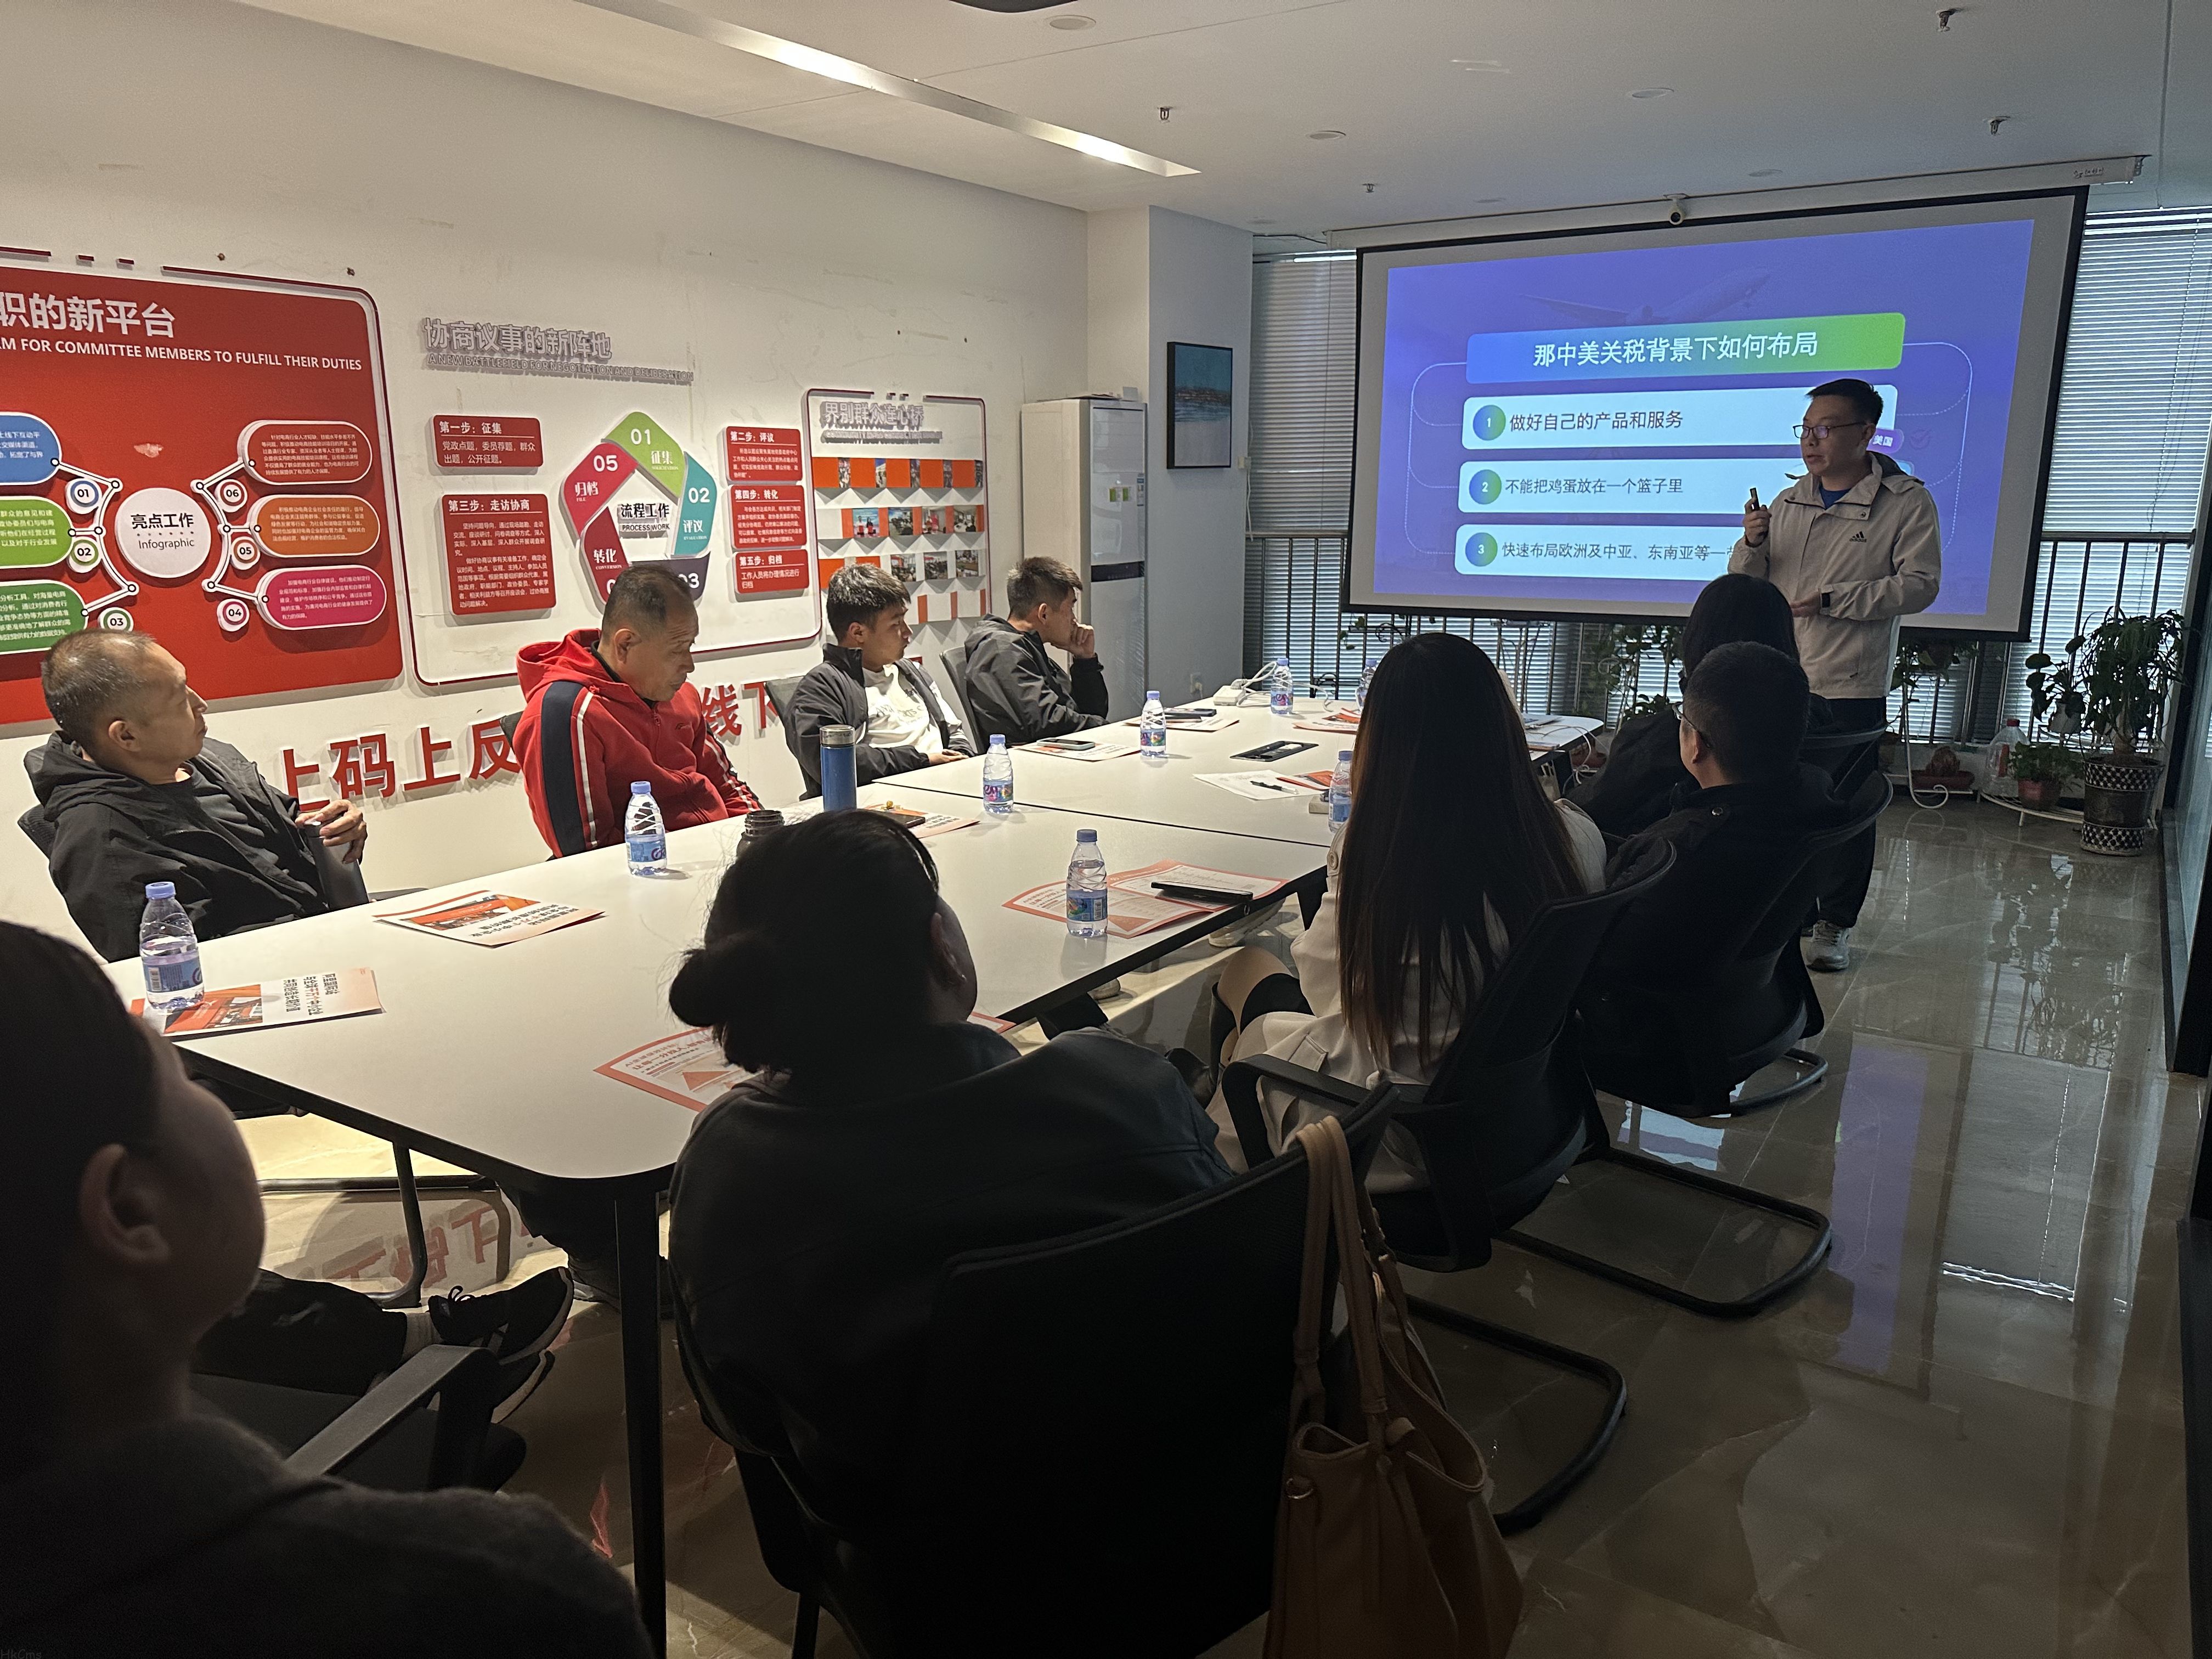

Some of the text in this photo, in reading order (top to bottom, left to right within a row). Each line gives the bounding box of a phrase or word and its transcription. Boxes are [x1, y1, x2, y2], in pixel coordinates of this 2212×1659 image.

[0, 291, 176, 338] 职的新平台
[424, 318, 613, 359] 协商议事的新阵地
[21, 338, 51, 353] FOR
[55, 340, 142, 358] COMMITTEE
[145, 346, 211, 362] MEMBERS
[215, 350, 232, 362] TO
[236, 352, 281, 366] FULFILL
[284, 356, 319, 368] THEIR
[322, 357, 362, 370] DUTIES
[1533, 331, 1818, 368] 那中美关税背景下如何布局
[428, 355, 693, 381] A NEW BATTLEFIELD FOR NEGOTIATION AND DELIBERATION
[825, 402, 924, 426] 界别群众连心桥
[1486, 410, 1683, 432] 1 做好自己的产品和服务
[439, 421, 502, 435] 第一步：征集
[631, 428, 651, 445] 01
[730, 431, 774, 442] 第二步：评议
[1872, 435, 1893, 447] 美国
[593, 455, 618, 472] 05
[651, 450, 673, 465] 征集
[77, 488, 89, 498] 01
[225, 488, 239, 498] 06
[574, 481, 599, 496] 归档
[1482, 478, 1683, 495] 2 不能把鸡蛋放在一个篮子里
[689, 487, 710, 503] 02
[735, 489, 778, 500] 第四步：转化
[448, 499, 529, 512] 第三步：走访协商
[620, 503, 669, 518] 流程工作
[131, 512, 194, 530] 亮点工作
[683, 519, 703, 533] 评议
[138, 537, 195, 551] Infographic
[239, 546, 252, 556] 05
[1478, 545, 1484, 554] 3
[77, 547, 92, 557] 02
[594, 548, 617, 563] 转化
[739, 555, 782, 566] 第五步：归档
[228, 608, 242, 618] 04
[110, 617, 123, 627] 03
[284, 720, 521, 811] 上码上反
